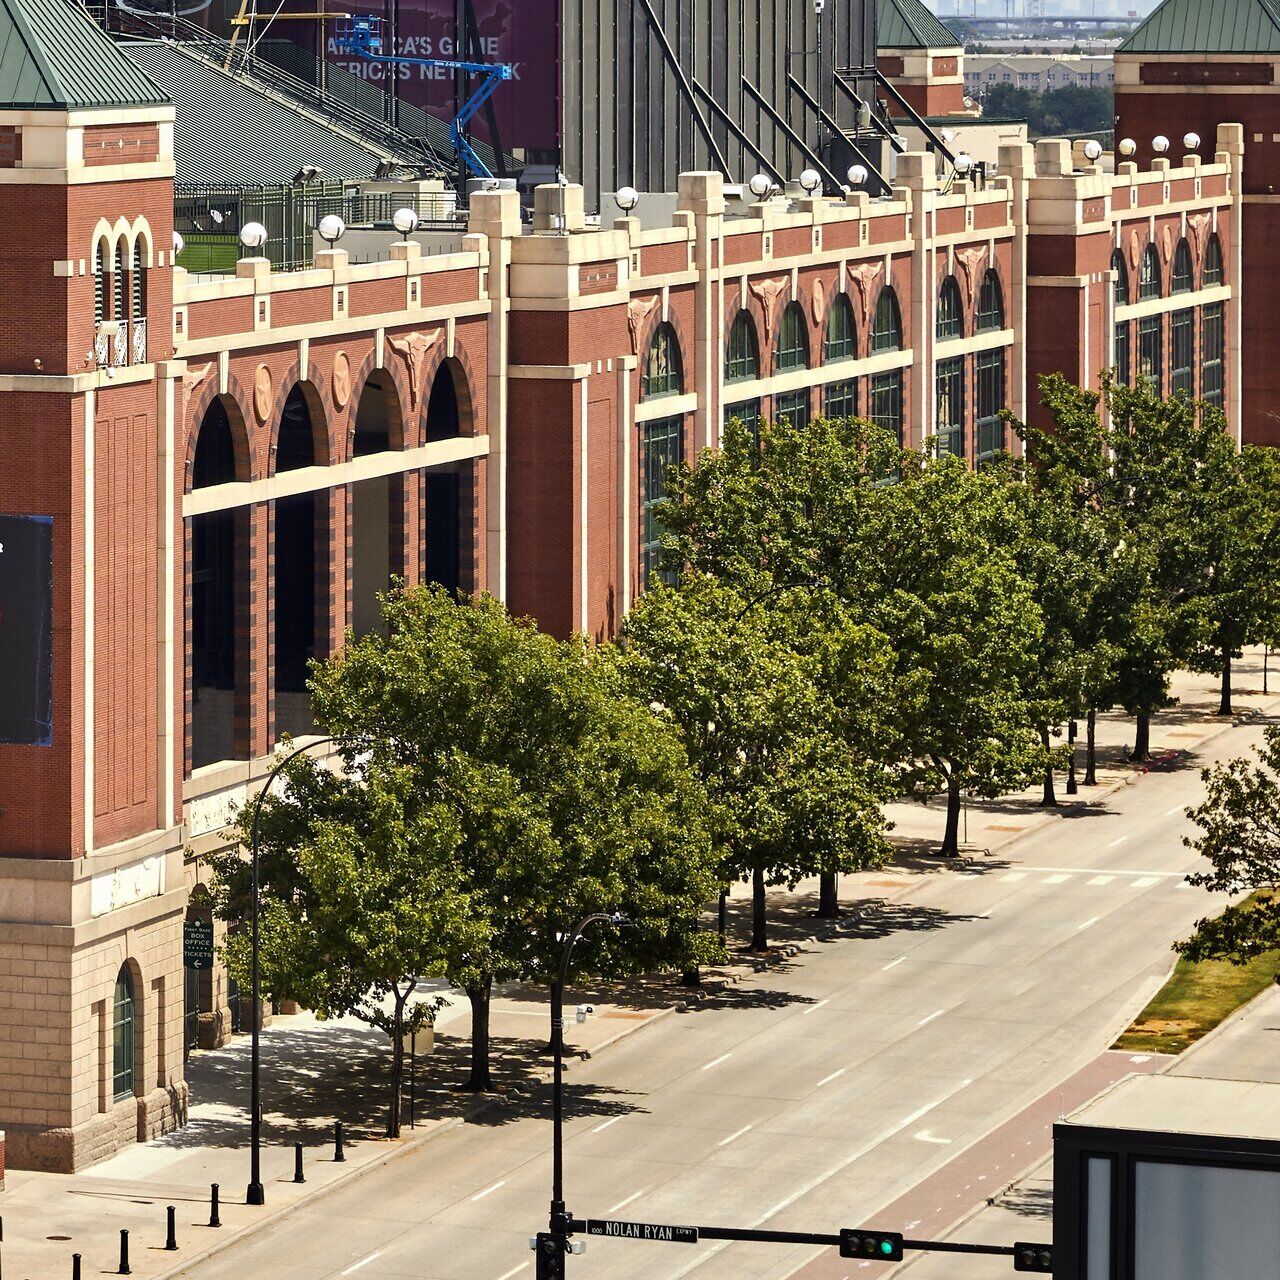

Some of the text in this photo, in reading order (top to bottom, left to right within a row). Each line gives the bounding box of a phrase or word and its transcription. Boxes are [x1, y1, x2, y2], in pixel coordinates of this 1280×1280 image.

[439, 36, 499, 55] GME
[606, 1222, 640, 1237] NOLAN
[644, 1225, 673, 1240] RYAN
